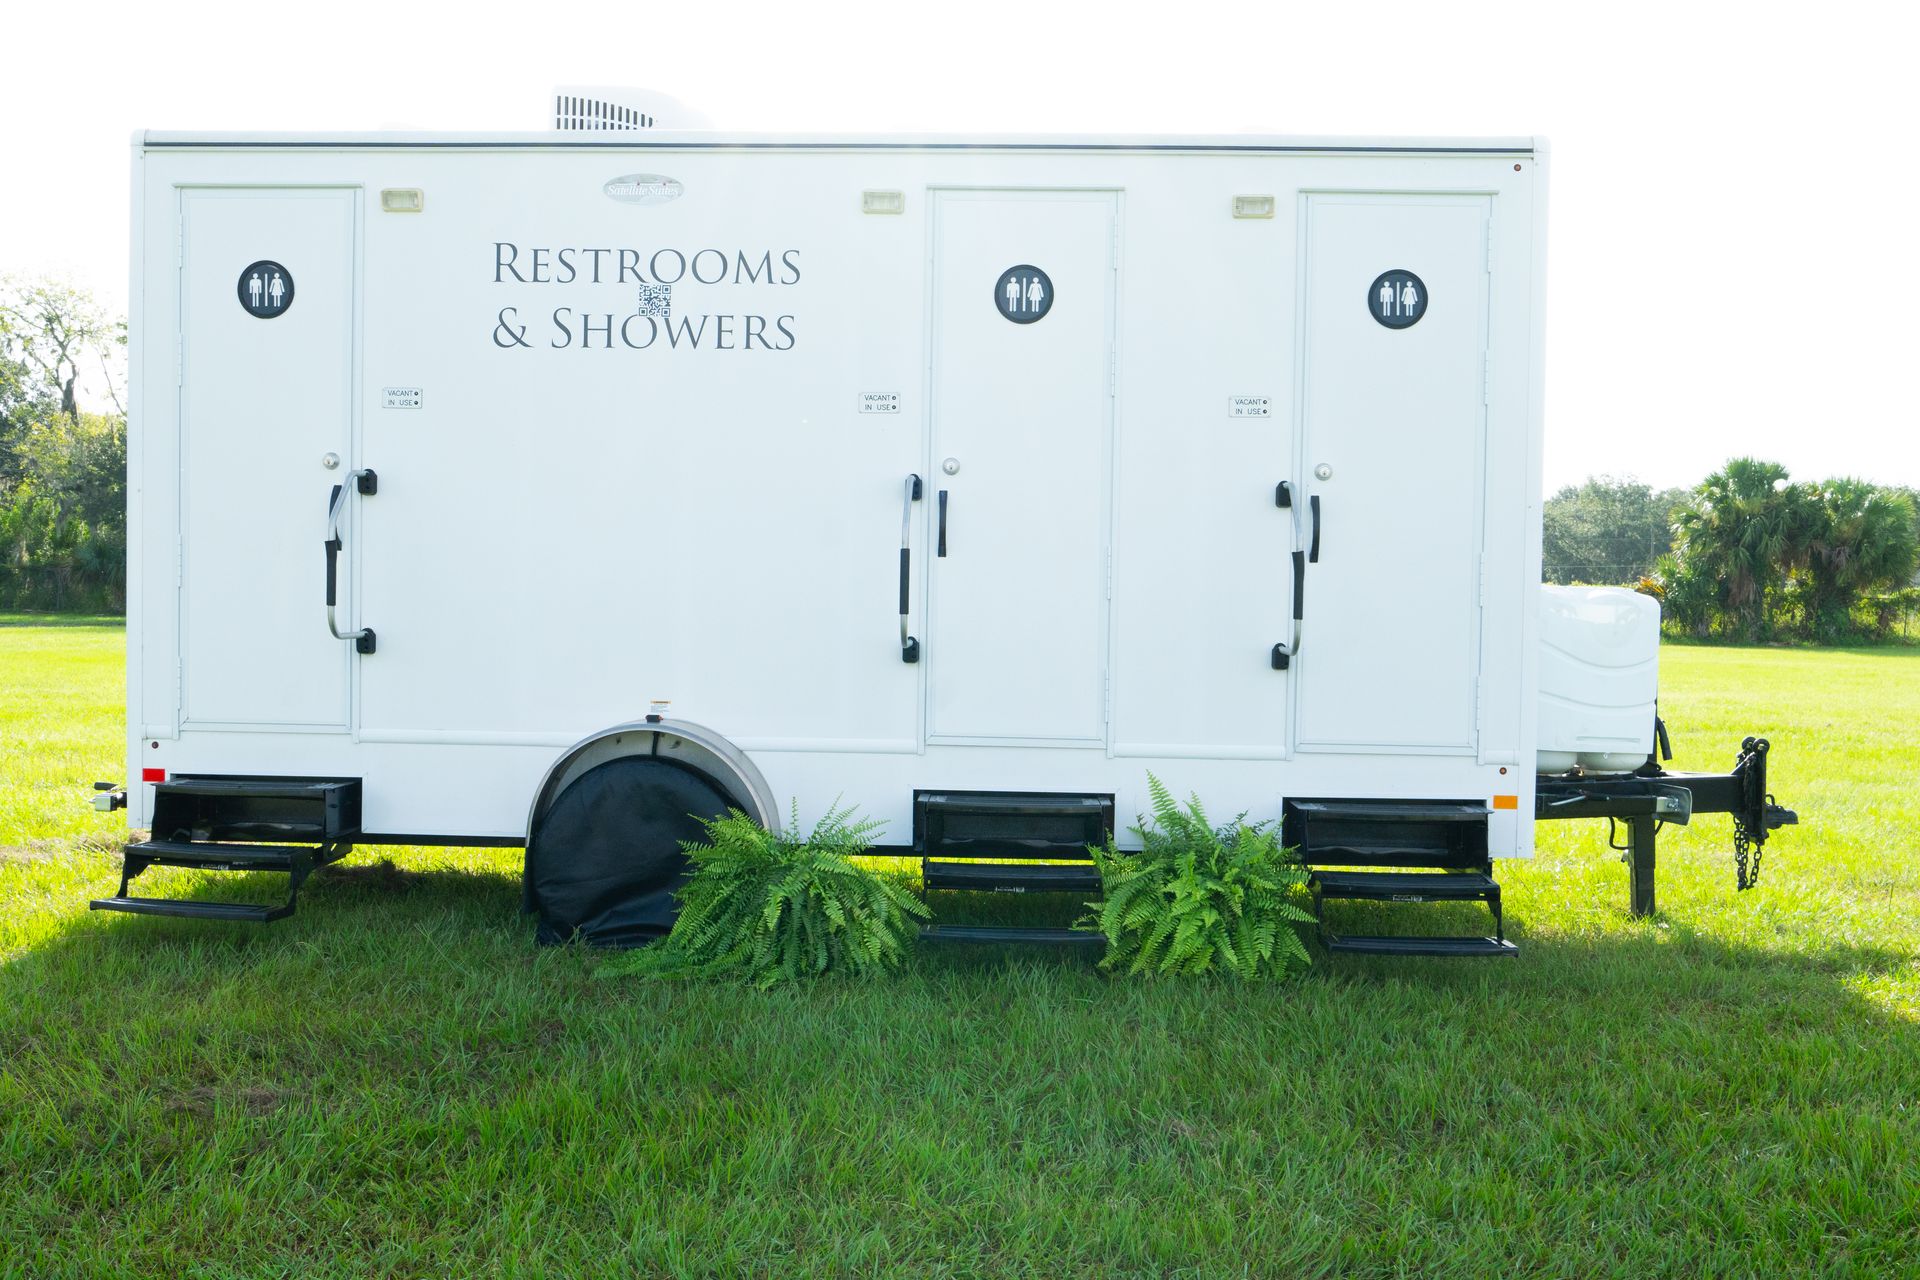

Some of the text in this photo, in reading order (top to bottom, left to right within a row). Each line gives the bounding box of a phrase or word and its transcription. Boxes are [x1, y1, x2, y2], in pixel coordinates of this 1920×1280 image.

[607, 185, 678, 196] Satellite Suites
[492, 242, 801, 285] RESTROOMS
[493, 307, 796, 351] & SHOWERS
[876, 403, 891, 411] USE
